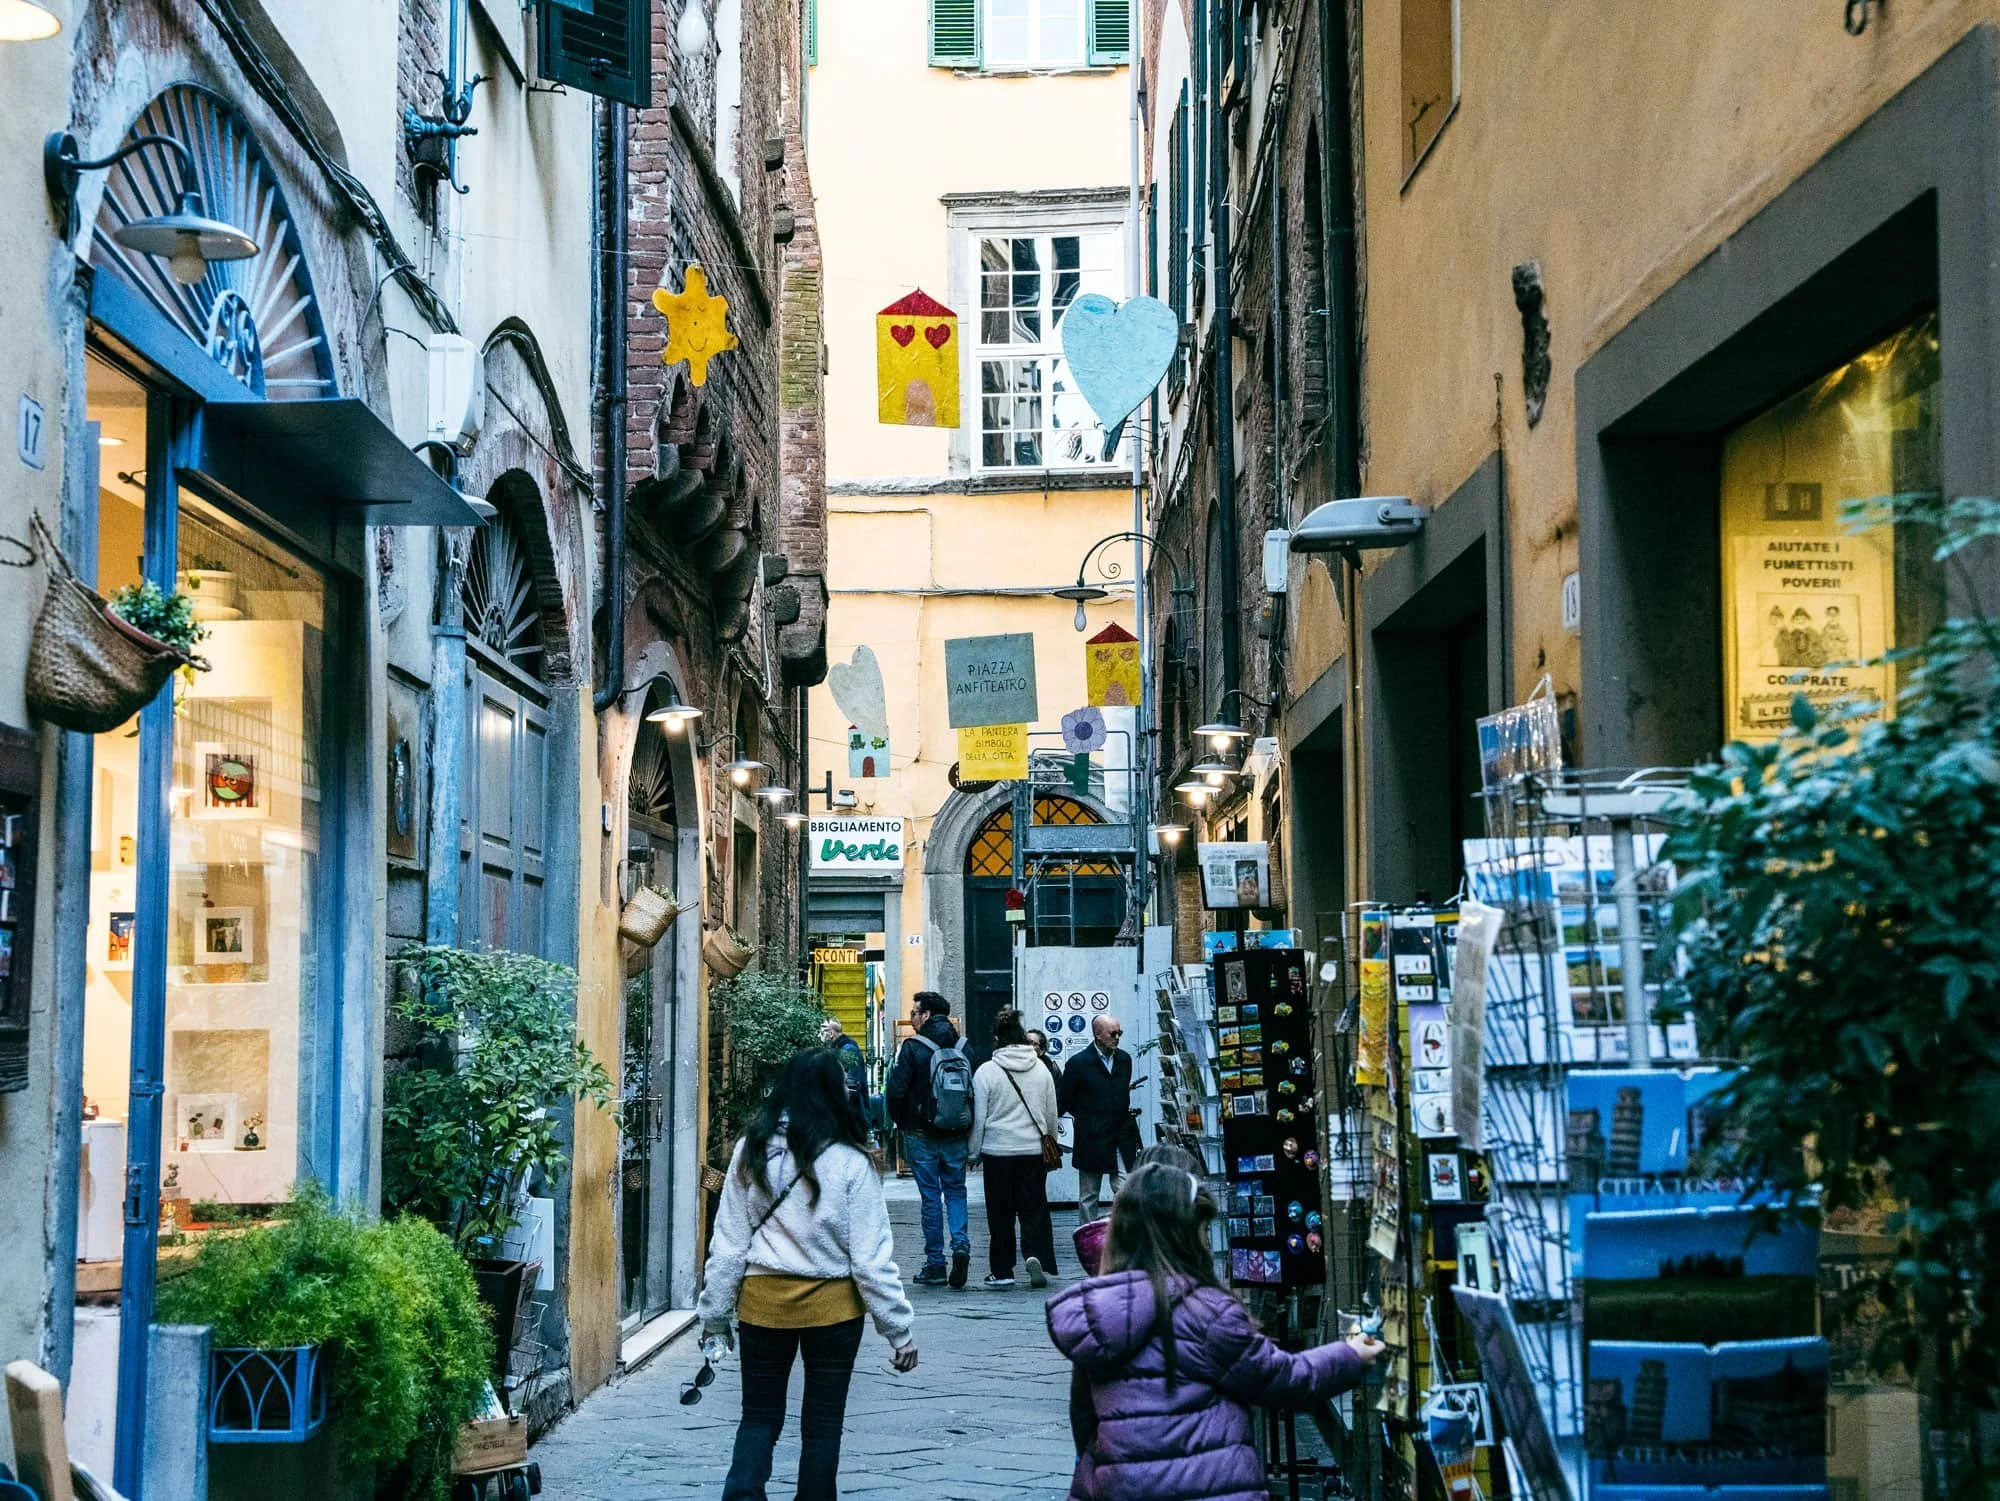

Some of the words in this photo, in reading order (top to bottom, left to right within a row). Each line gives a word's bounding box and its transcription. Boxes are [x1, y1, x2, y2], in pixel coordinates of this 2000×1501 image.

[24, 408, 41, 455] 17
[1767, 541, 1831, 553] AIUTATE
[1834, 542, 1840, 553] I
[1763, 560, 1854, 571] FUMETTISTI
[967, 661, 1015, 676] PIAZZA
[955, 678, 1027, 695] ANFITEATRO
[964, 728, 975, 737] LA
[981, 727, 1019, 737] PANTERA
[975, 739, 1012, 749] SIMBOLO
[820, 838, 900, 862] Verde
[909, 936, 920, 944] 24
[815, 950, 857, 963] SCONTI
